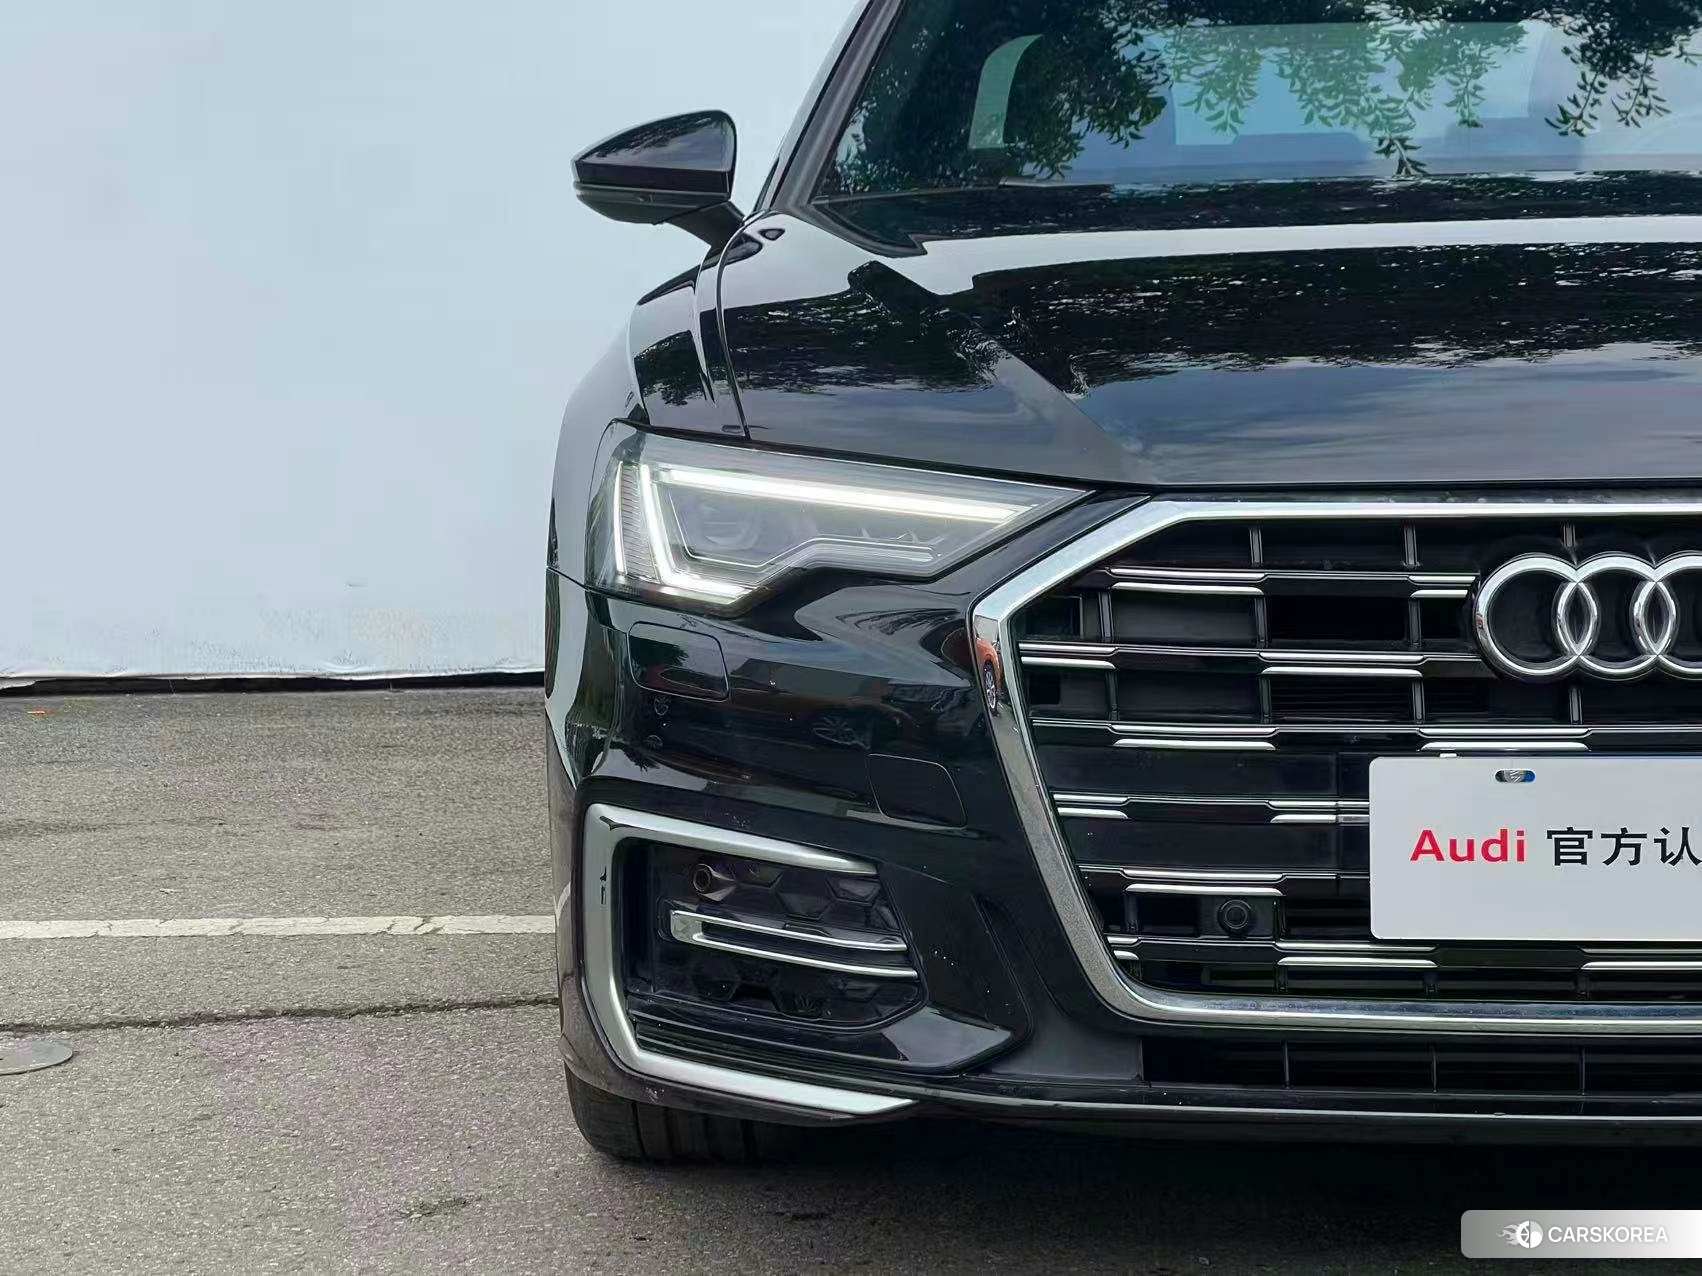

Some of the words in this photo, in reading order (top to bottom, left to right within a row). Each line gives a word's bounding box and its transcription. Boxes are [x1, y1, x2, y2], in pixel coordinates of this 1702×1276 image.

[1410, 828, 1526, 862] Audi
[1546, 827, 1702, 867] 官方认
